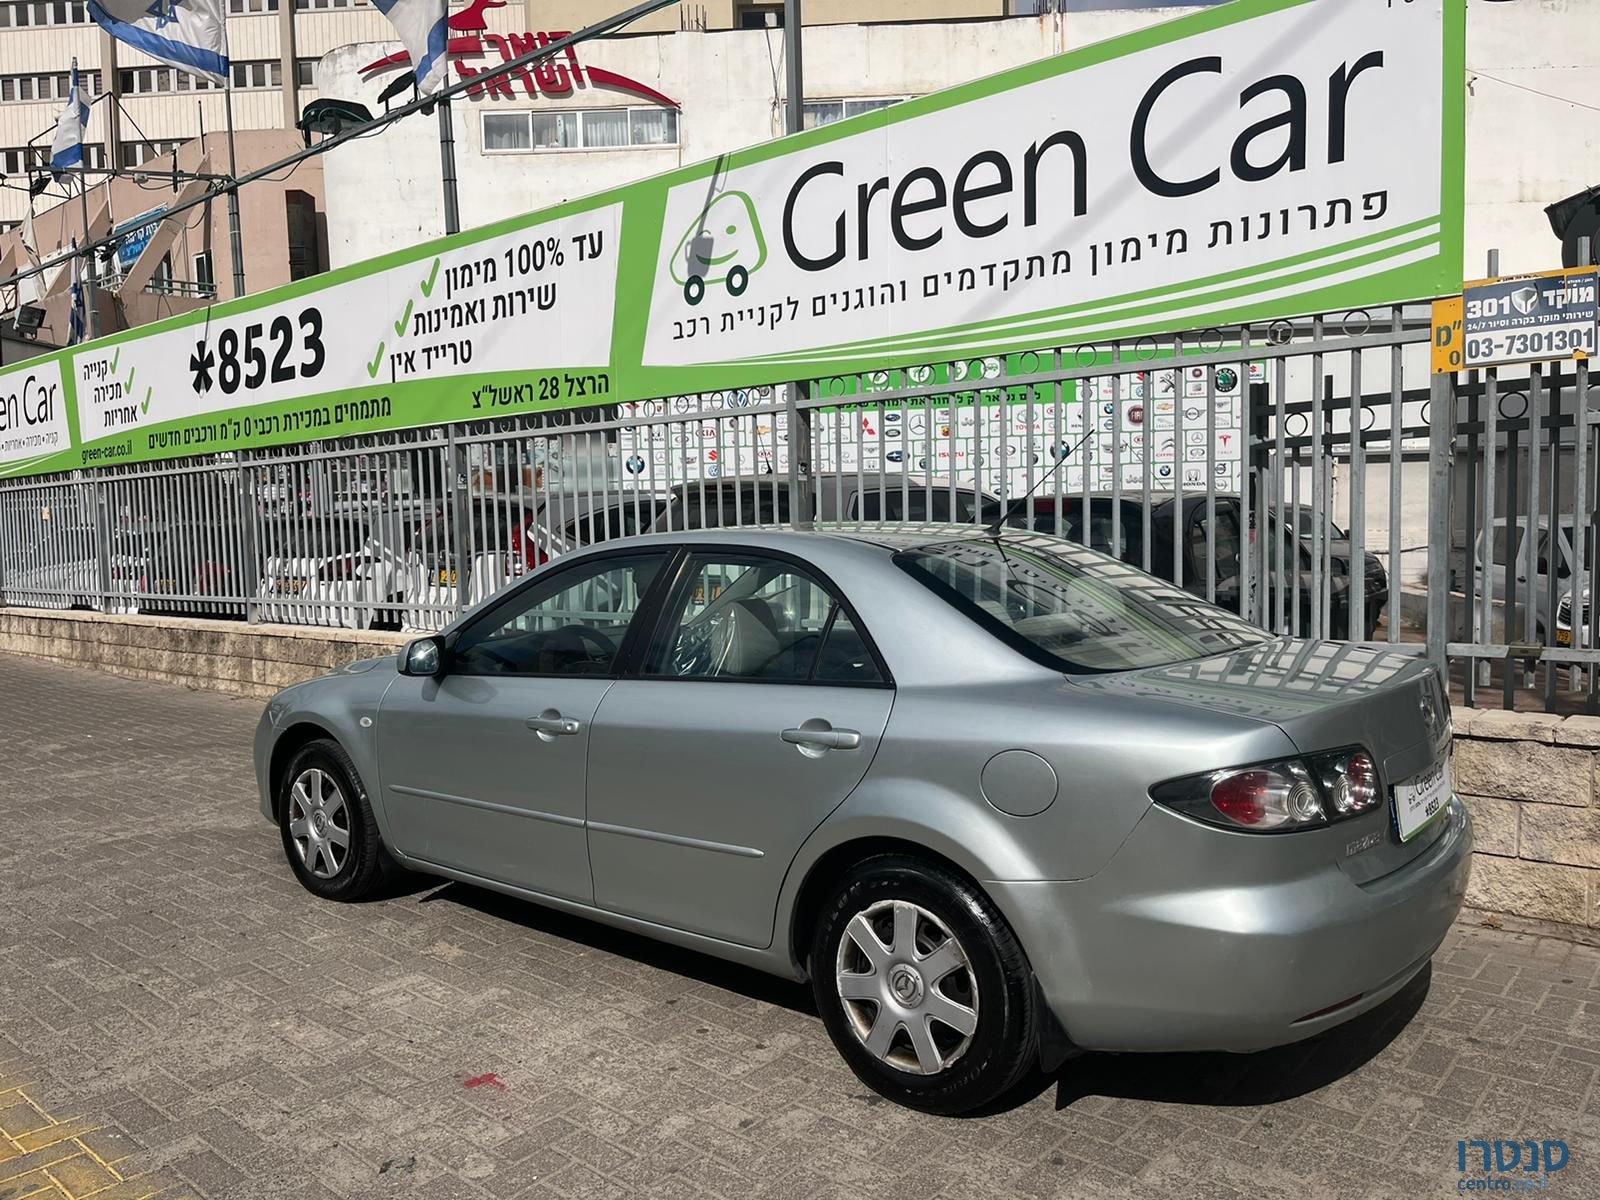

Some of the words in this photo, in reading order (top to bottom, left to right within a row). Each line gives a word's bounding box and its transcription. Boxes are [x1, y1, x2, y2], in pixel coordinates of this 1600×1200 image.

[782, 130, 1087, 272] Green
[1130, 50, 1384, 198] Car
[1208, 190, 1388, 249] פתרונות
[504, 237, 564, 278] 100%
[572, 230, 603, 261] עד
[1090, 228, 1188, 276] מימון
[445, 257, 497, 300] מימון
[923, 249, 1071, 298] מתקדמים
[492, 283, 556, 320] שירות
[812, 279, 907, 317] והוגנים
[1466, 296, 1510, 319] 301
[413, 299, 486, 337] ואמינות
[720, 296, 799, 331] לקניית
[1511, 317, 1535, 327] בקרה
[1538, 315, 1560, 323] מוקד
[1562, 310, 1594, 320] שירותי
[673, 316, 710, 340] רכב
[1467, 321, 1486, 332] 24/7
[422, 339, 472, 370] טרייד
[1467, 327, 1594, 360] 03-7301301
[83, 359, 108, 382] קנייה
[390, 349, 416, 383] אין
[94, 381, 123, 404] מכירה
[538, 377, 560, 401] 28
[564, 373, 610, 399] הרצל
[23, 375, 57, 426] Car
[334, 396, 391, 417] מתמחים
[103, 405, 138, 428] אחריות
[244, 419, 251, 437] 0
[254, 417, 280, 438] רכבי
[282, 406, 330, 431] במכירת
[148, 432, 181, 450] חדשים
[184, 426, 217, 444] ורכבים
[82, 441, 132, 465] green-car.co.il
